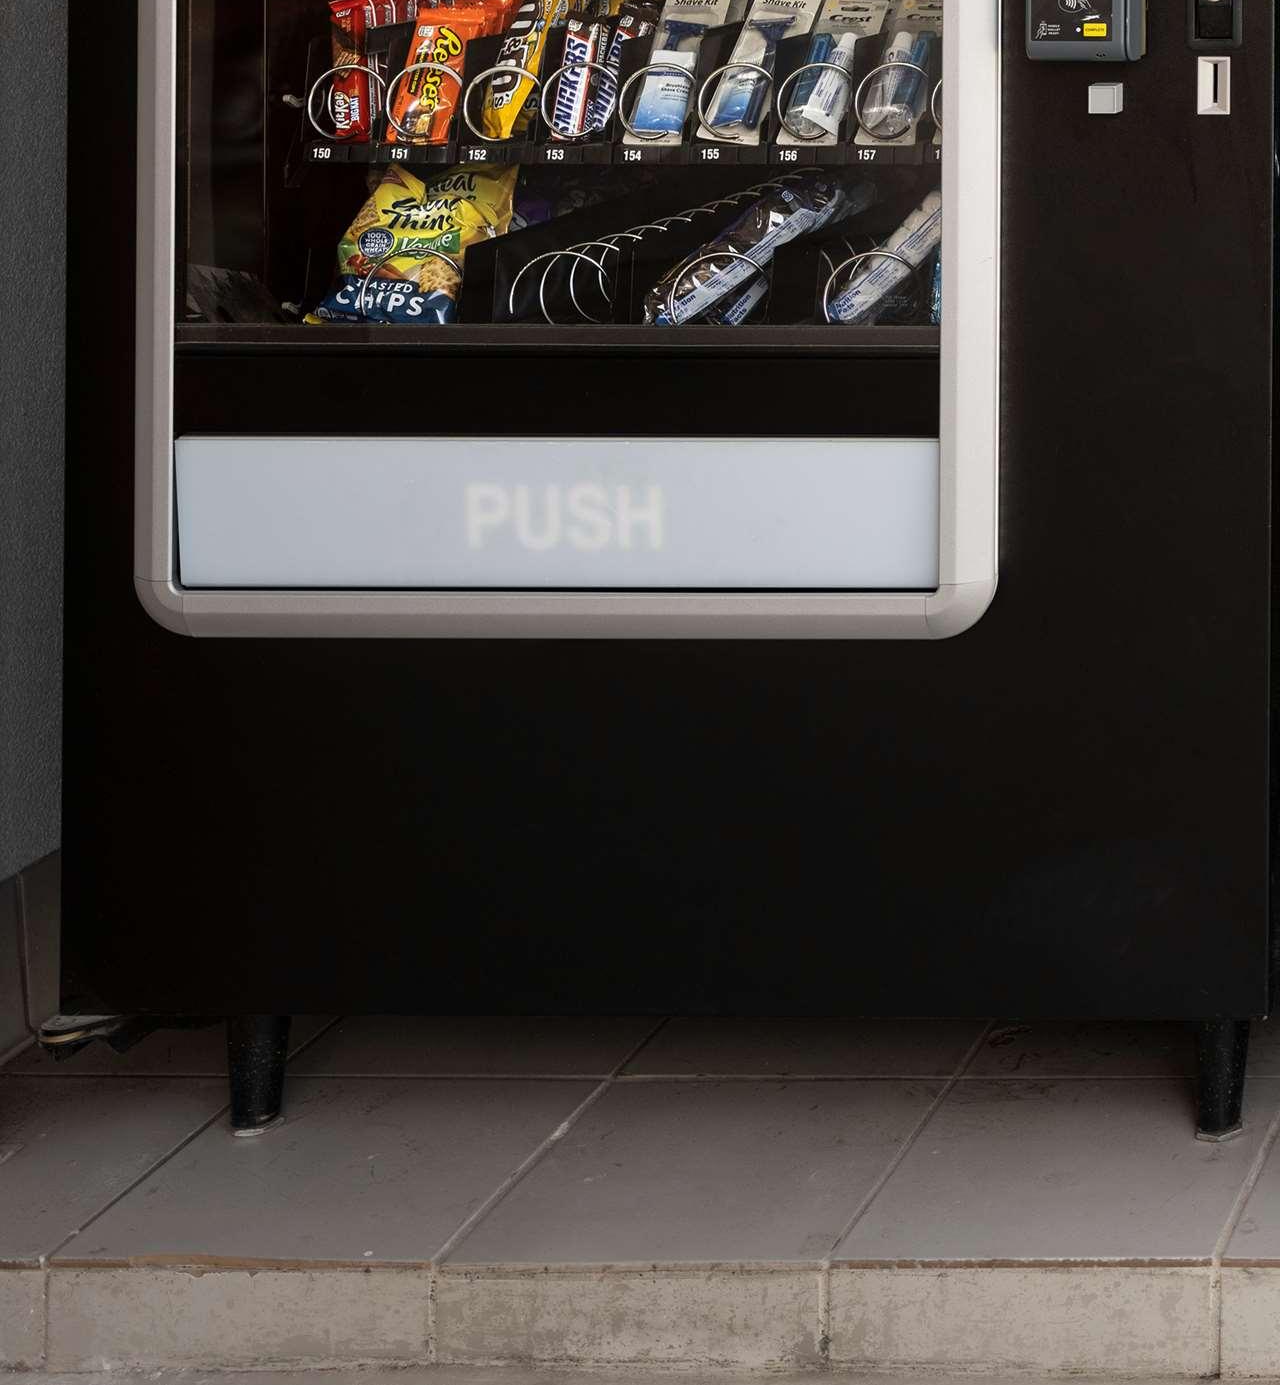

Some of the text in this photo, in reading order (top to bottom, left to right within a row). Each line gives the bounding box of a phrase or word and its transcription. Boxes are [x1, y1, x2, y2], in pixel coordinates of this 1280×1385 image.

[790, 0, 806, 9] Kit
[829, 14, 873, 22] Crest
[312, 148, 331, 159] 150
[391, 148, 408, 159] 151
[468, 149, 487, 160] 152
[546, 149, 565, 160] 153
[623, 150, 642, 161] 154
[701, 148, 720, 159] 155
[778, 150, 798, 161] 156
[857, 149, 876, 160] 157
[381, 209, 462, 231] Thins
[335, 284, 425, 316] CHIPS
[464, 482, 665, 551] PUSH
